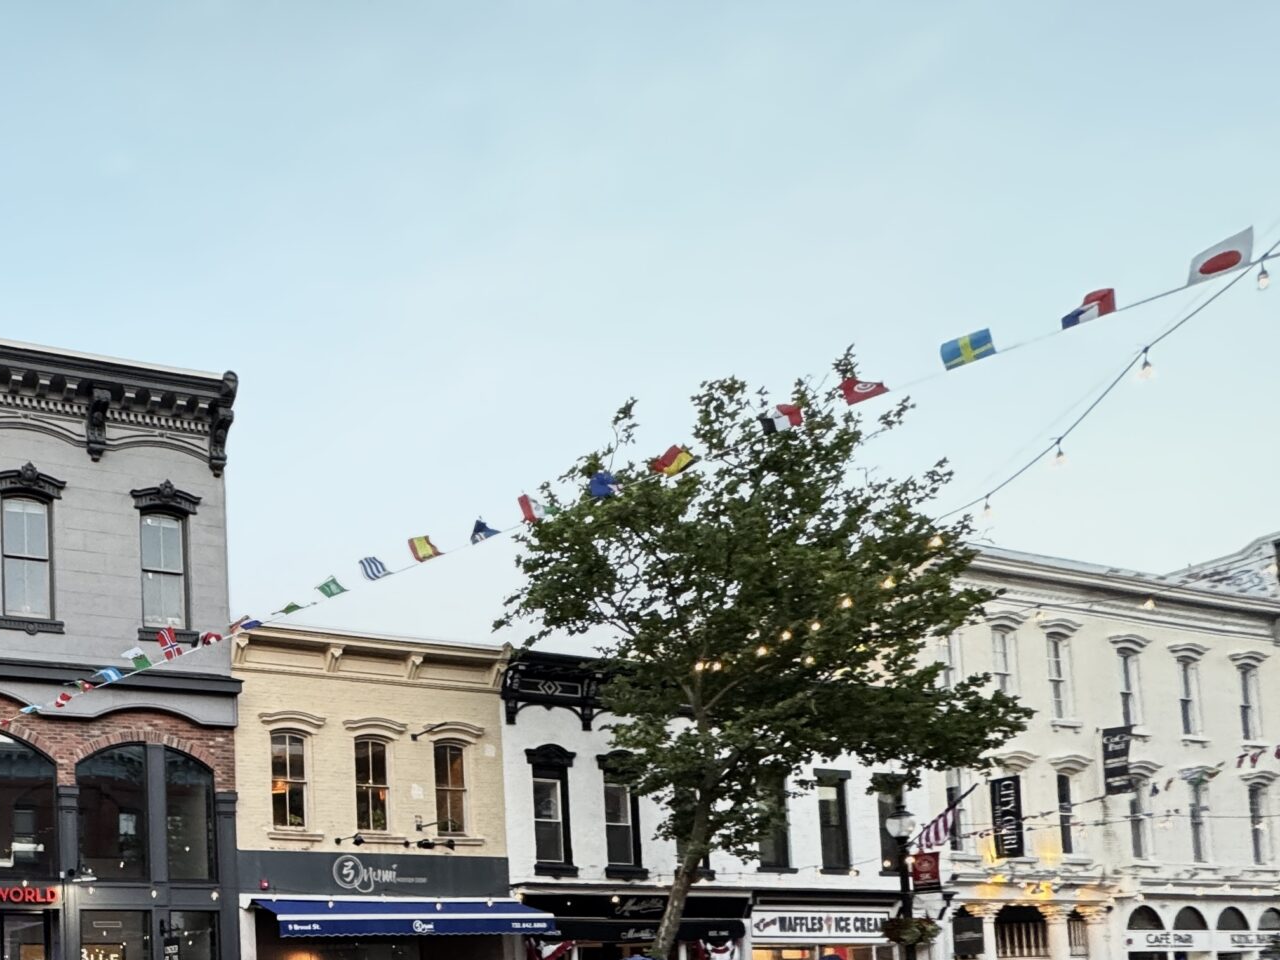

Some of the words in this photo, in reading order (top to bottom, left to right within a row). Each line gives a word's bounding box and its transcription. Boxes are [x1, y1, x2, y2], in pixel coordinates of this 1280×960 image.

[1000, 781, 1016, 812] CITY
[778, 916, 823, 932] WAFFLES
[835, 917, 851, 932] ICE
